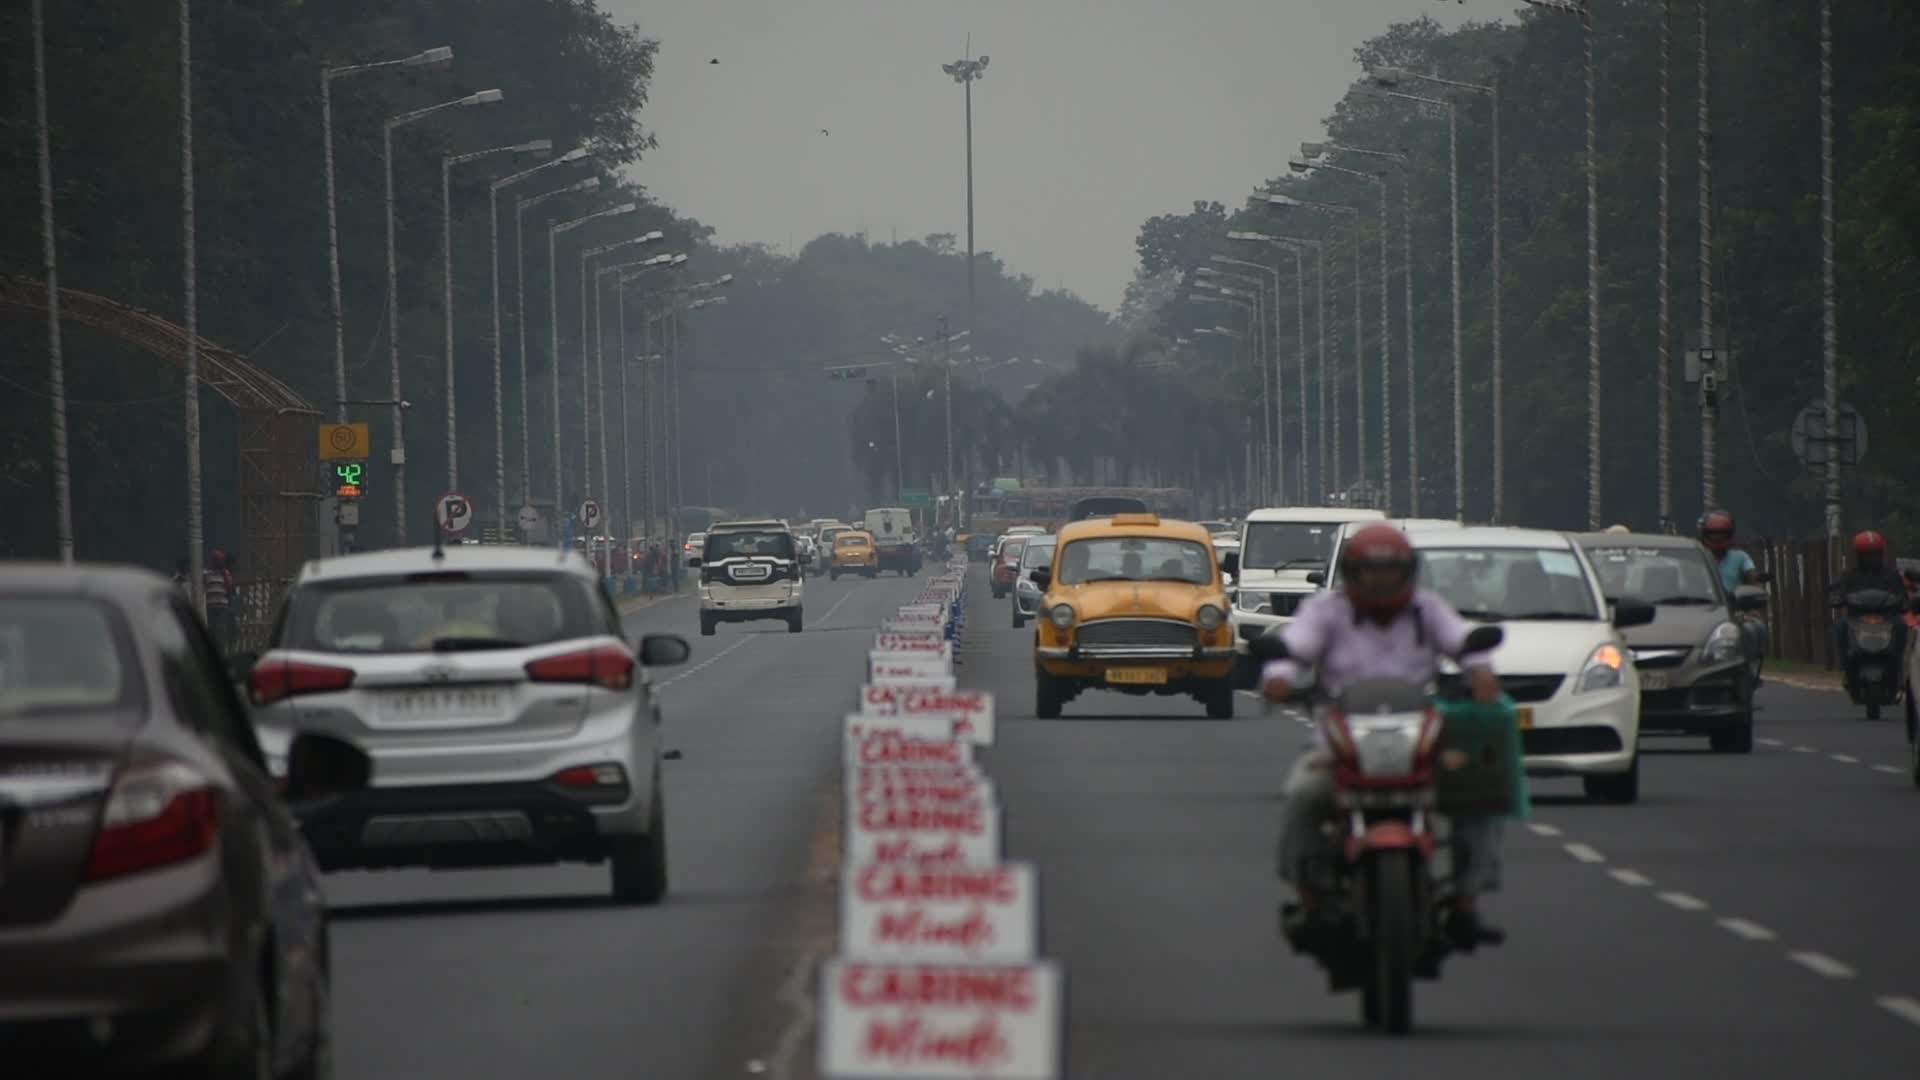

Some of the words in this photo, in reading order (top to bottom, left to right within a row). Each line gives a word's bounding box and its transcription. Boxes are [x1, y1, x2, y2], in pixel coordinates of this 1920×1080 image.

[337, 464, 361, 485] 42
[445, 501, 467, 529] P
[585, 503, 598, 526] P
[855, 866, 1019, 905] CARING
[839, 964, 1038, 1013] CARING
